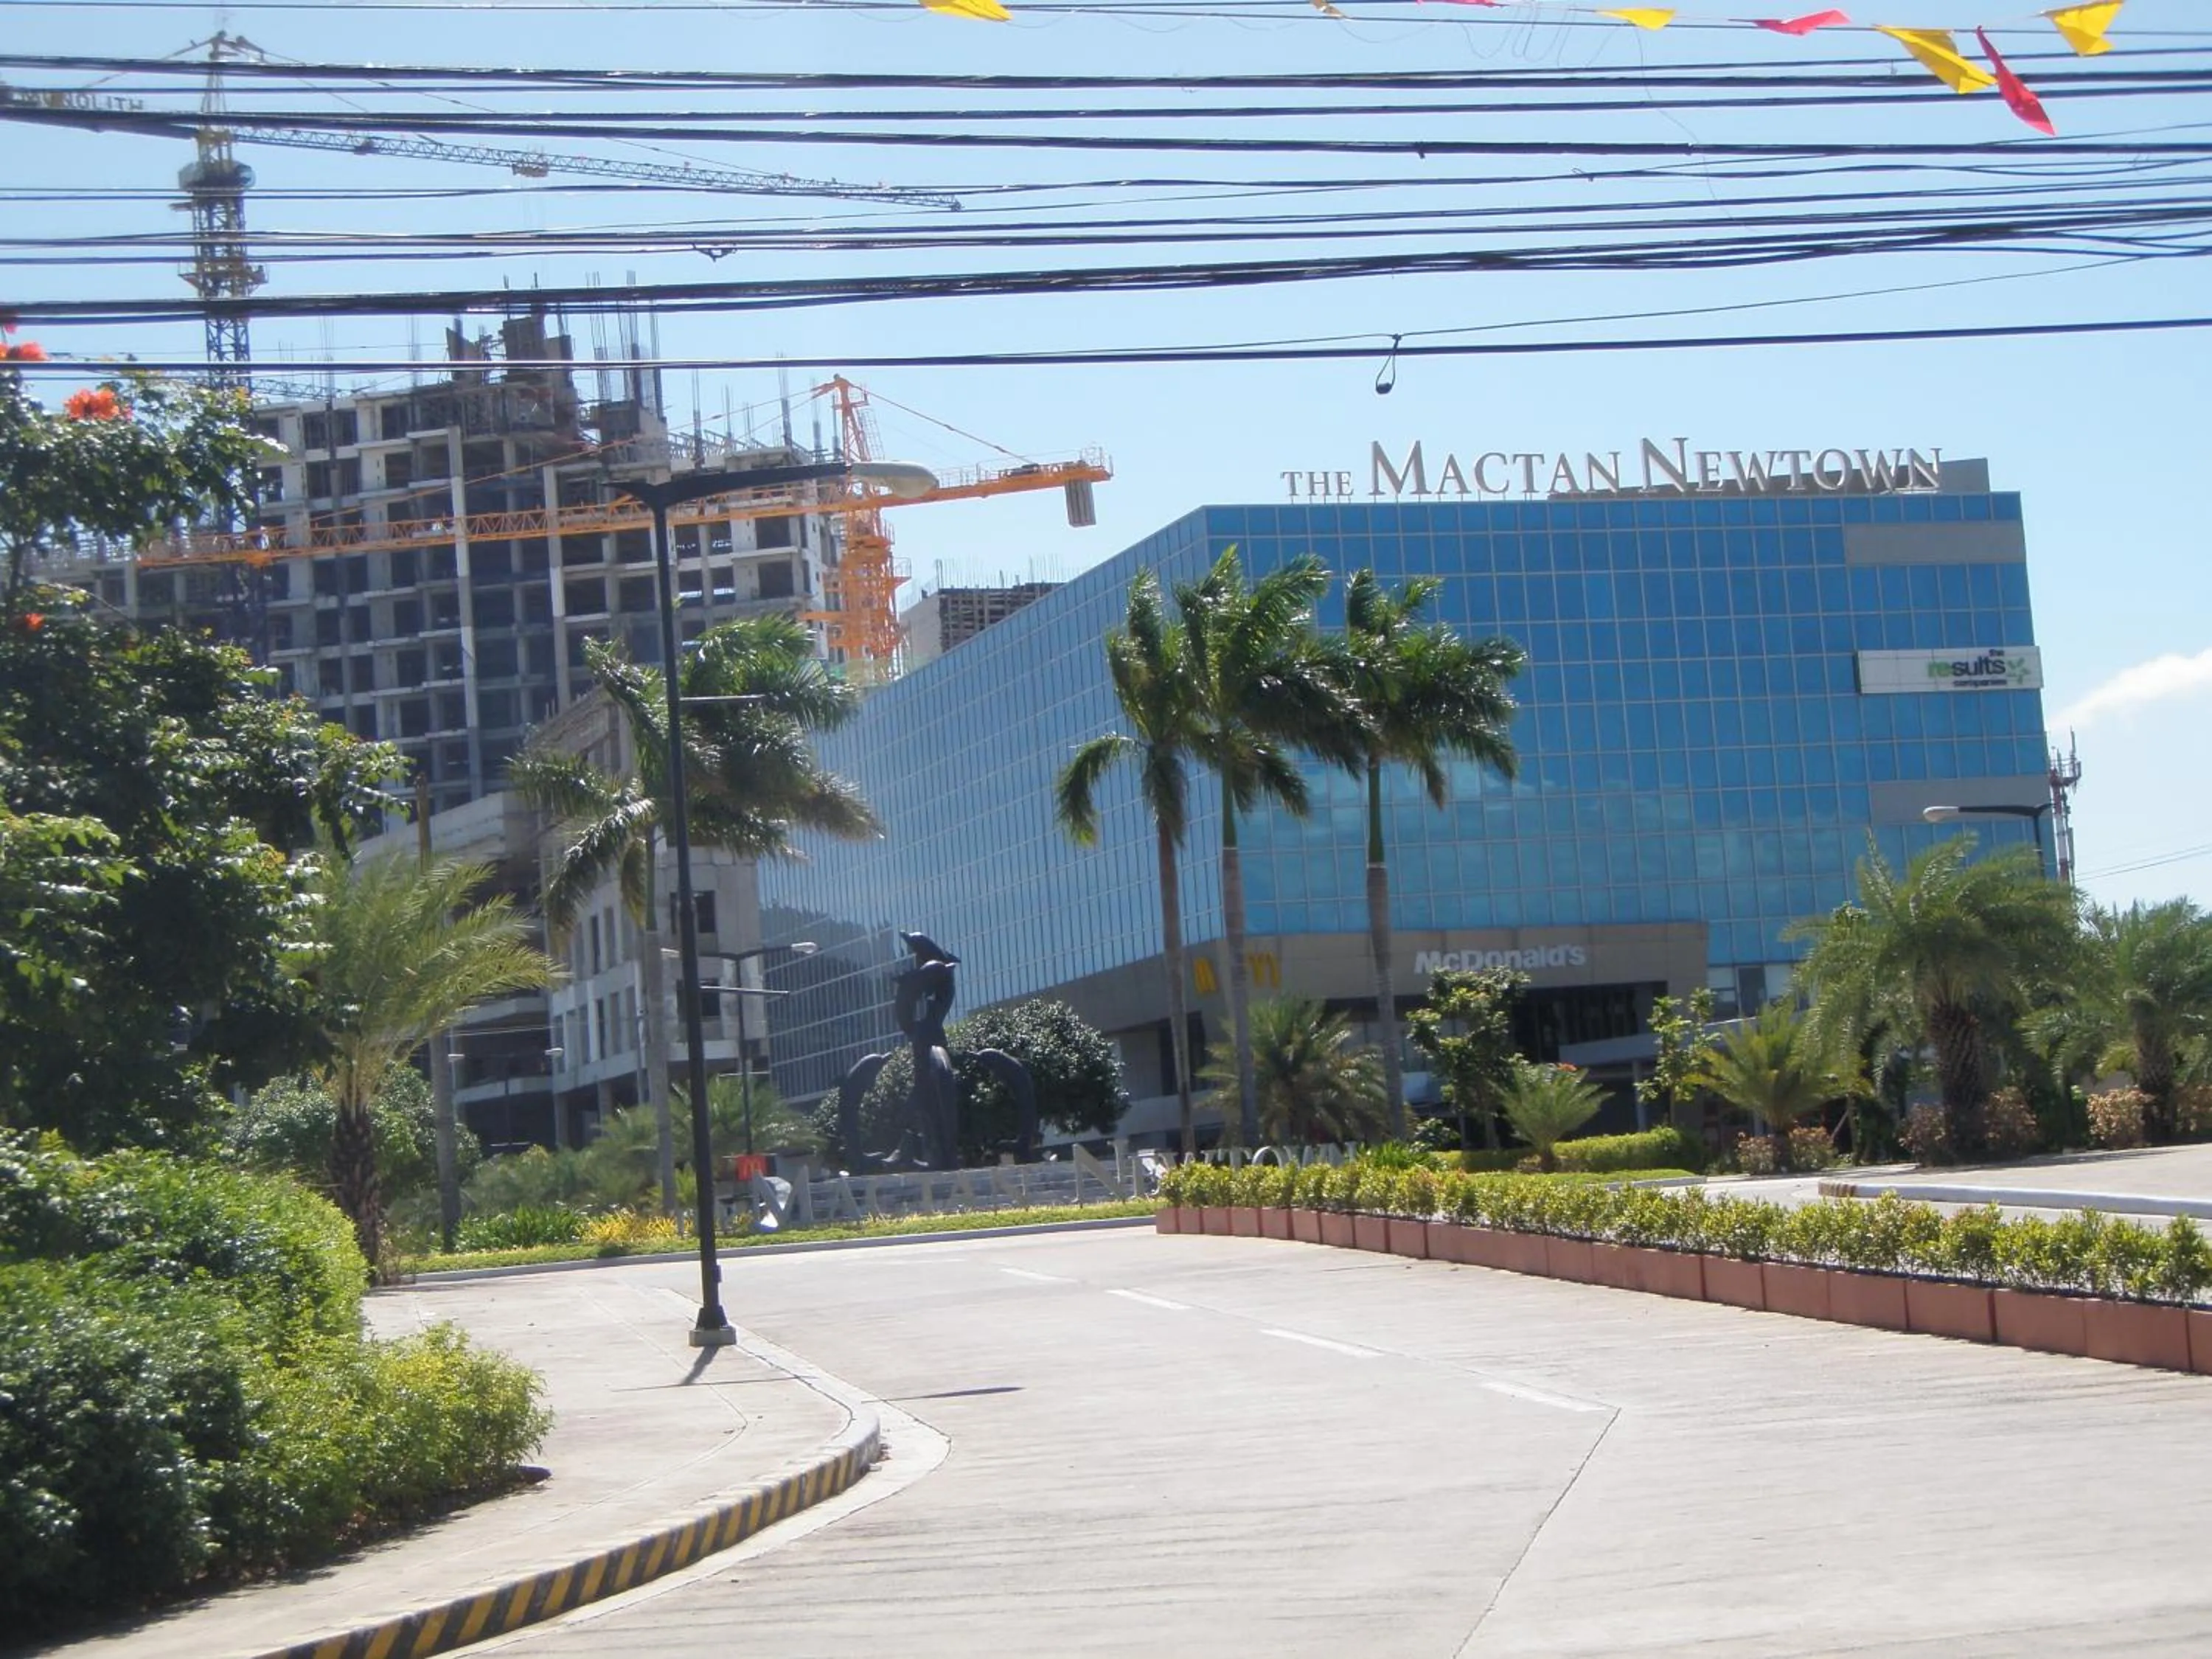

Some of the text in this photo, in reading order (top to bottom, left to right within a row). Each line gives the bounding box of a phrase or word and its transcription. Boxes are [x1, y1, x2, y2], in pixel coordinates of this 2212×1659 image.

[1280, 437, 1942, 496] THE MACTAN NEWTOWN
[1927, 656, 2006, 678] results
[1413, 943, 1586, 974] McDonald's
